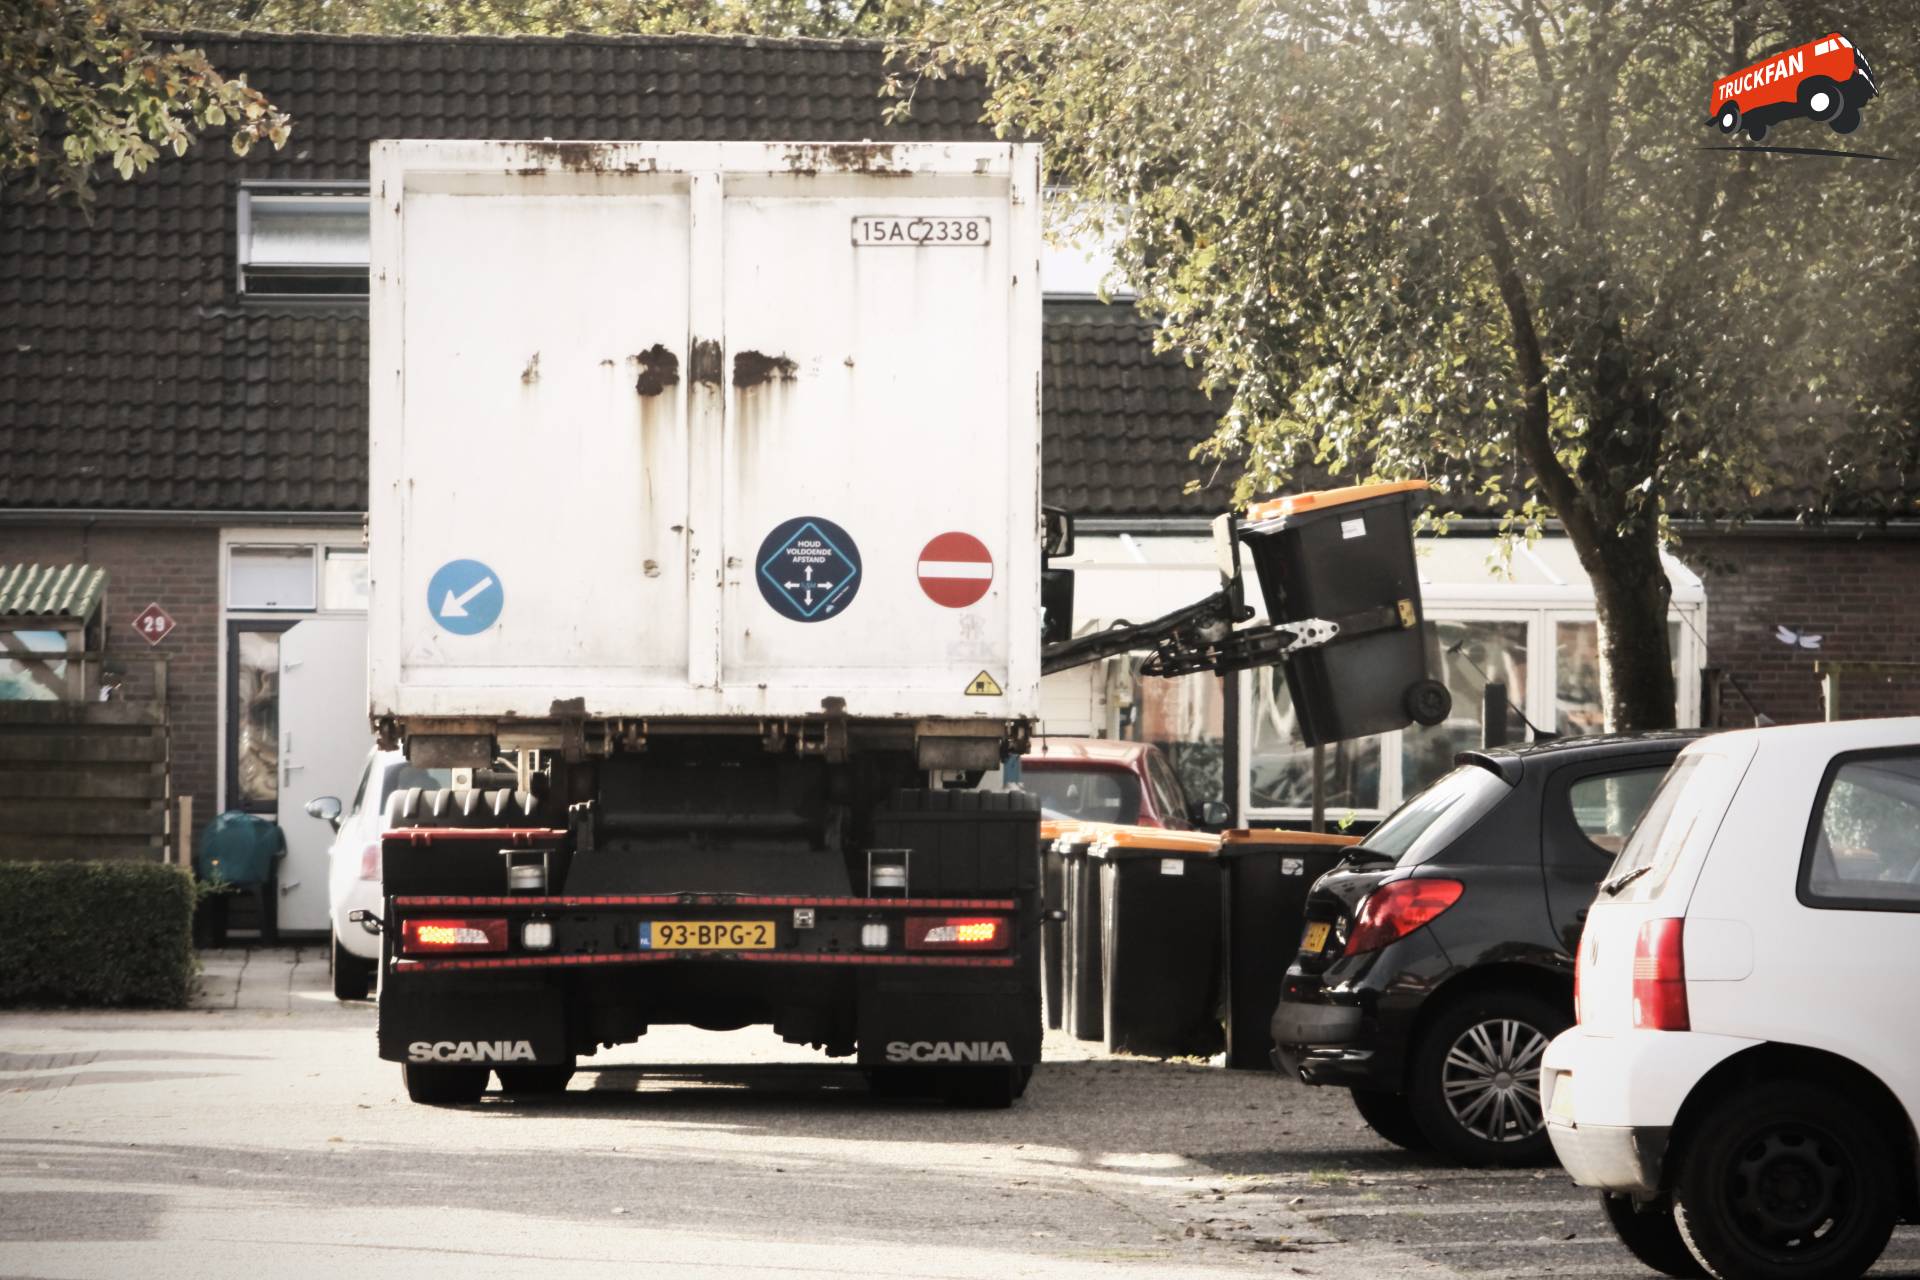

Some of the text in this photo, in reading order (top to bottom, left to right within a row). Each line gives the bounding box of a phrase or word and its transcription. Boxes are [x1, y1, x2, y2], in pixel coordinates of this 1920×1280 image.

[863, 221, 979, 241] 15AC2338
[786, 548, 832, 556] VOLDOENDE
[797, 540, 821, 548] HOUD
[792, 556, 826, 564] AFSTAND
[143, 615, 166, 632] 29
[660, 925, 767, 945] 93-BPG-2
[407, 1040, 537, 1063] SCANIA
[885, 1040, 1013, 1063] SCANIA
